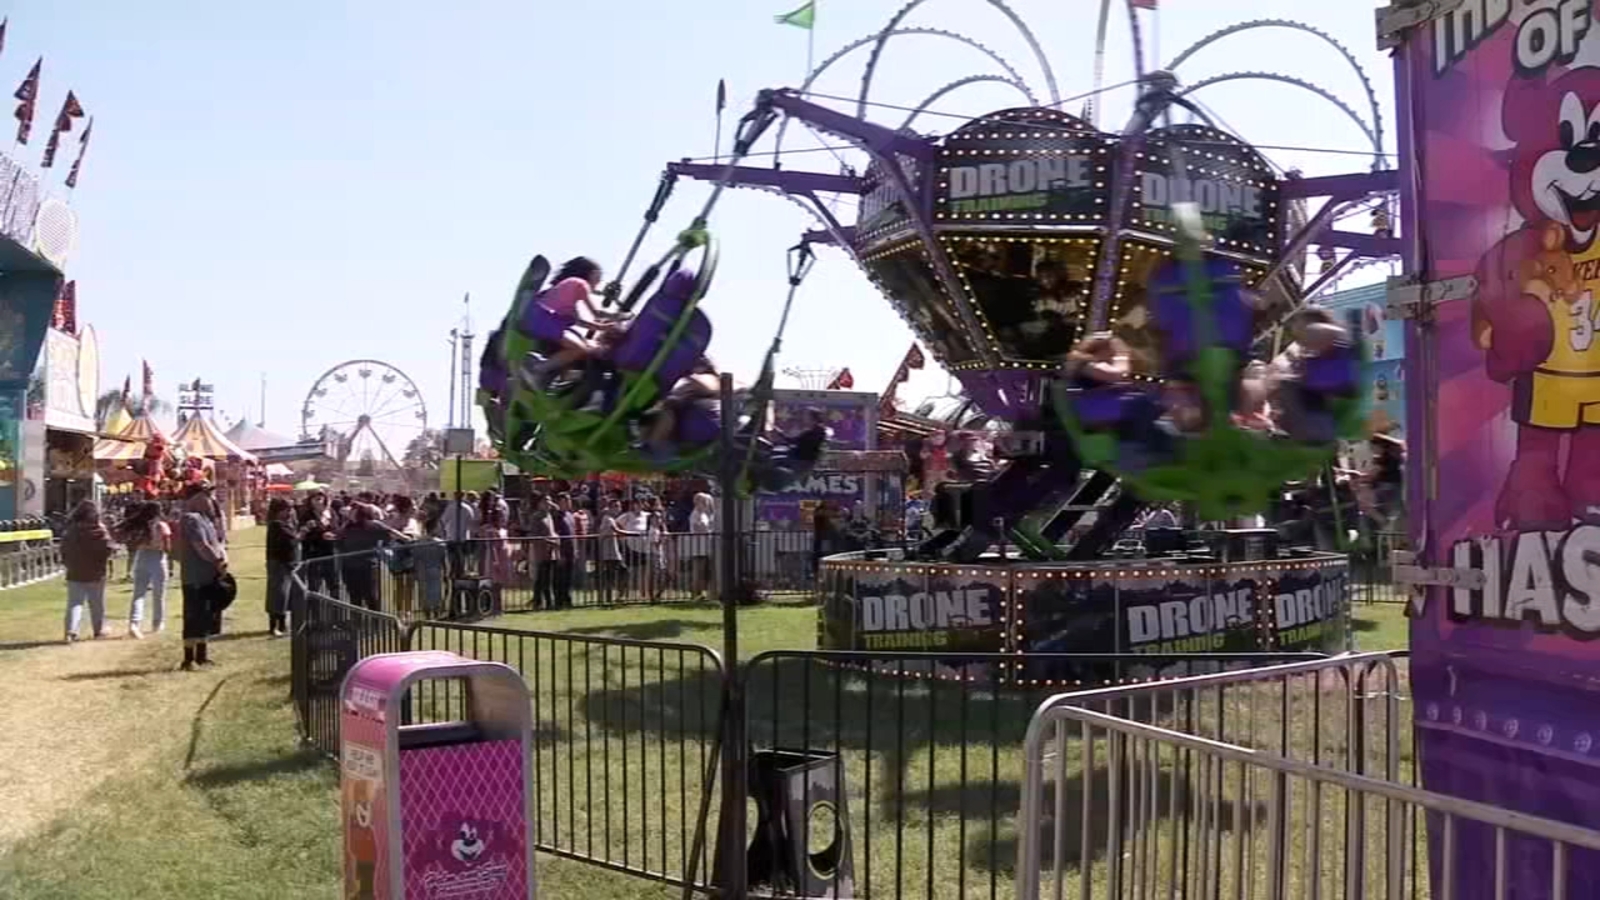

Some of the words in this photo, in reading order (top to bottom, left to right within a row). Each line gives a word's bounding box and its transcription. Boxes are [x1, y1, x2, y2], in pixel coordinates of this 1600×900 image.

[1517, 0, 1588, 69] OF
[950, 157, 1090, 198] DRONE
[783, 474, 859, 494] AMES
[863, 588, 991, 632] DRONE
[1128, 587, 1255, 643] DRONE
